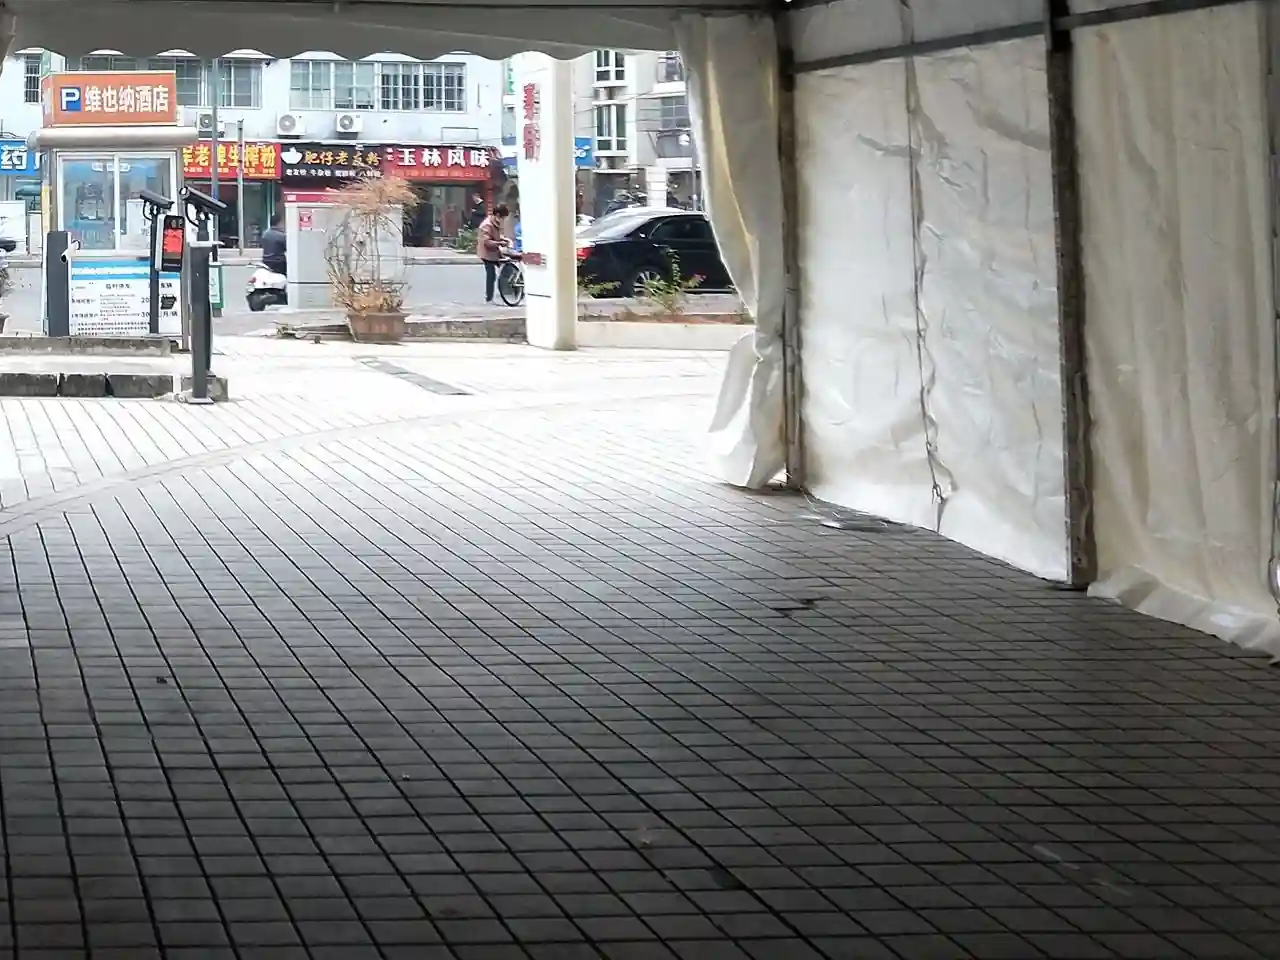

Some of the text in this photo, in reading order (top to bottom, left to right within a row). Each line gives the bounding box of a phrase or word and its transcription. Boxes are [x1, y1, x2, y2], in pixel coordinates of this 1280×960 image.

[85, 84, 169, 113] 维也纳酒店
[397, 148, 490, 168] 玉林风味
